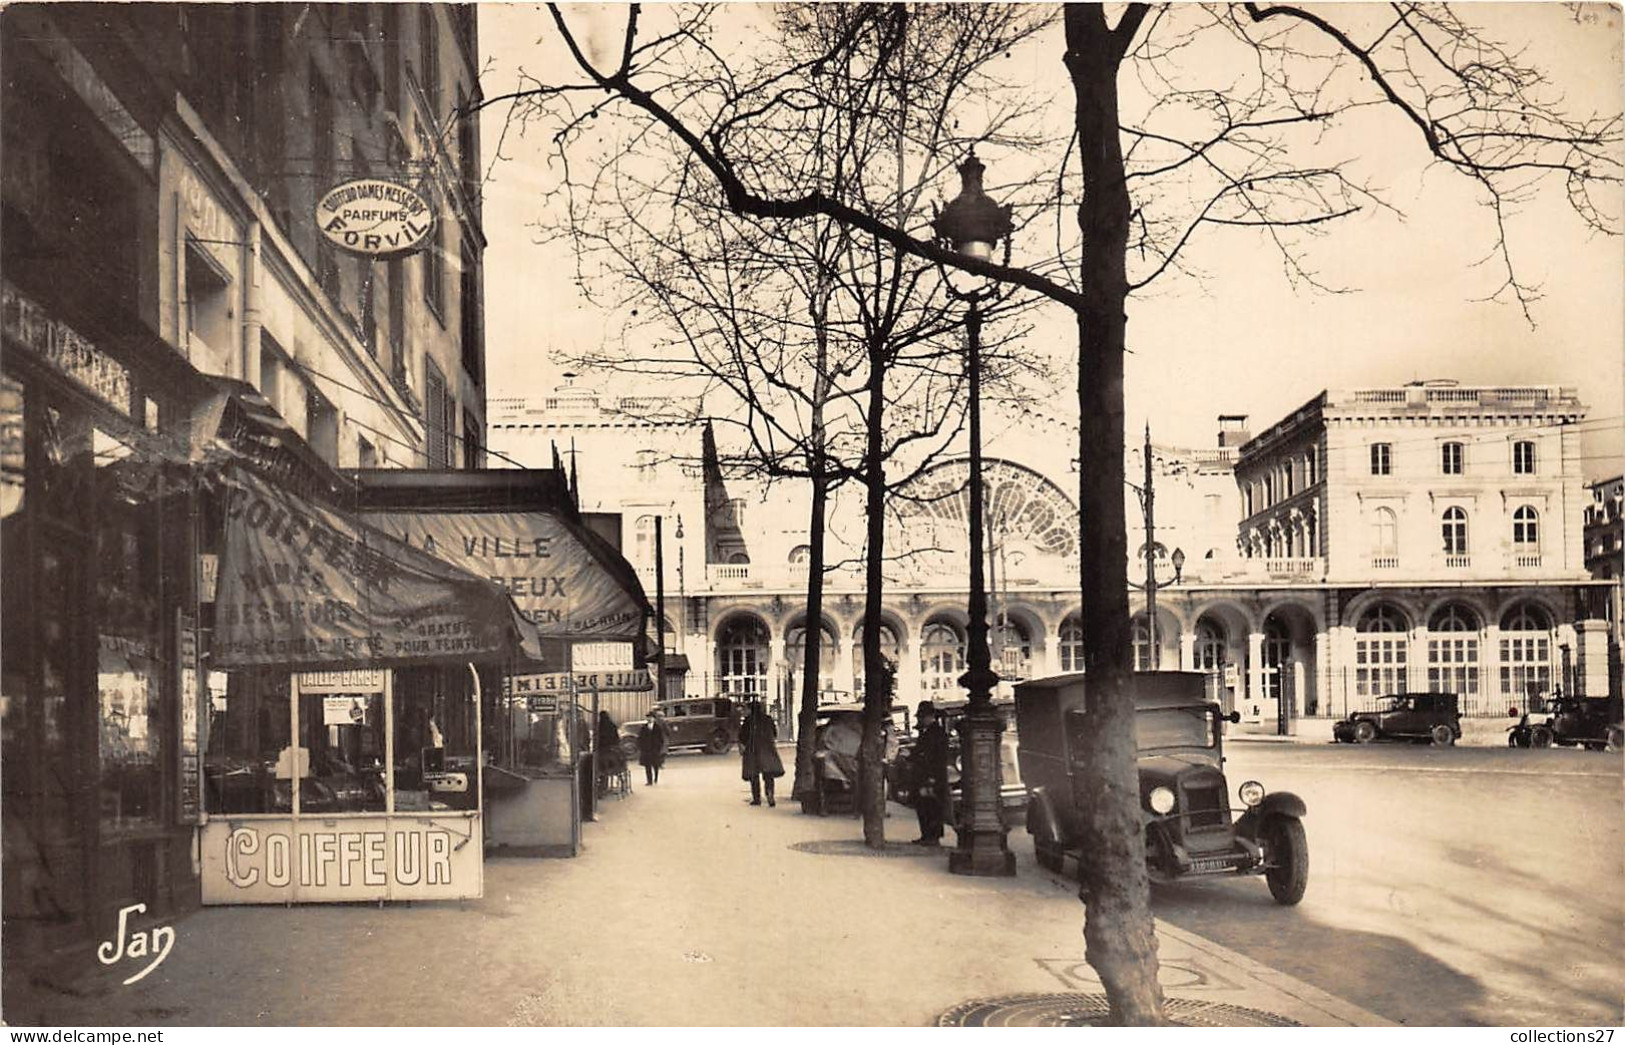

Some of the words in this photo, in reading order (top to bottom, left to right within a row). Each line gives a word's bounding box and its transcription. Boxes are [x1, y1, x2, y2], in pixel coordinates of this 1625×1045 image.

[357, 184, 385, 201] DAMES
[343, 209, 408, 222] PARFUMS
[463, 535, 551, 558] VILLE
[226, 828, 452, 888] COIFFEUR
